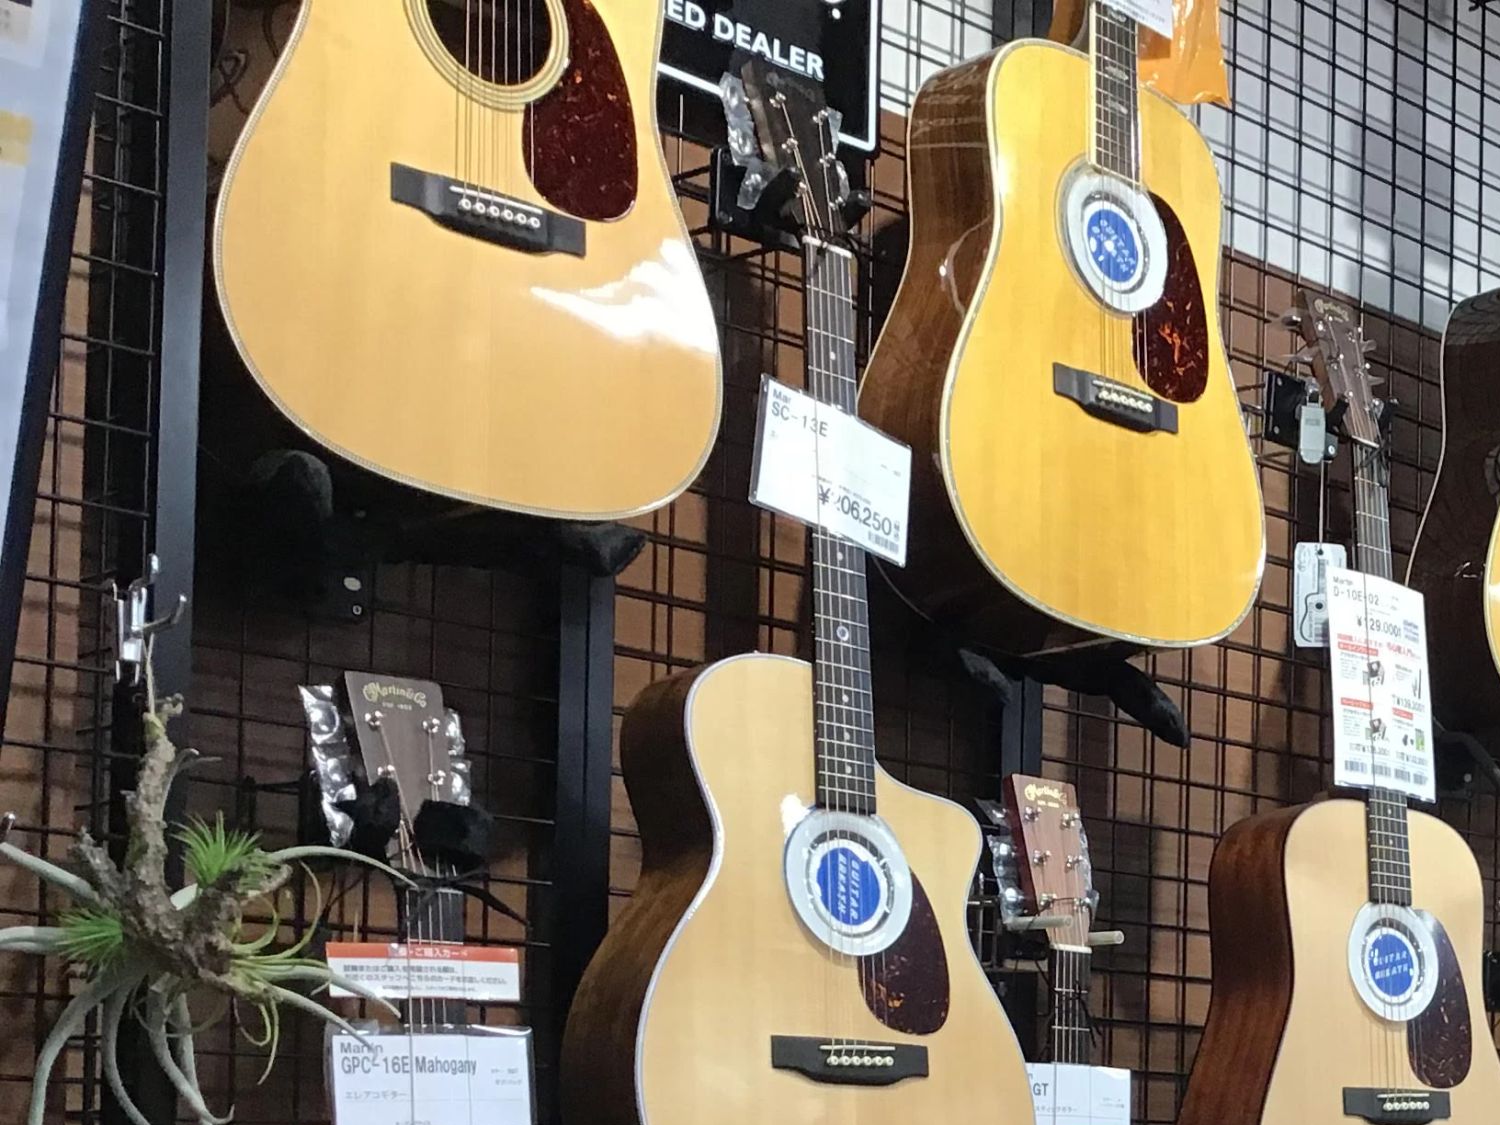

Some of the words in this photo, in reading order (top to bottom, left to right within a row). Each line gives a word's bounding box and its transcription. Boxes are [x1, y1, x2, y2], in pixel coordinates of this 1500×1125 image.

[713, 16, 826, 81] DEALER
[772, 402, 829, 438] SC-13E
[341, 1055, 410, 1075] GPC-16E
[415, 1055, 477, 1076] Mahogany
